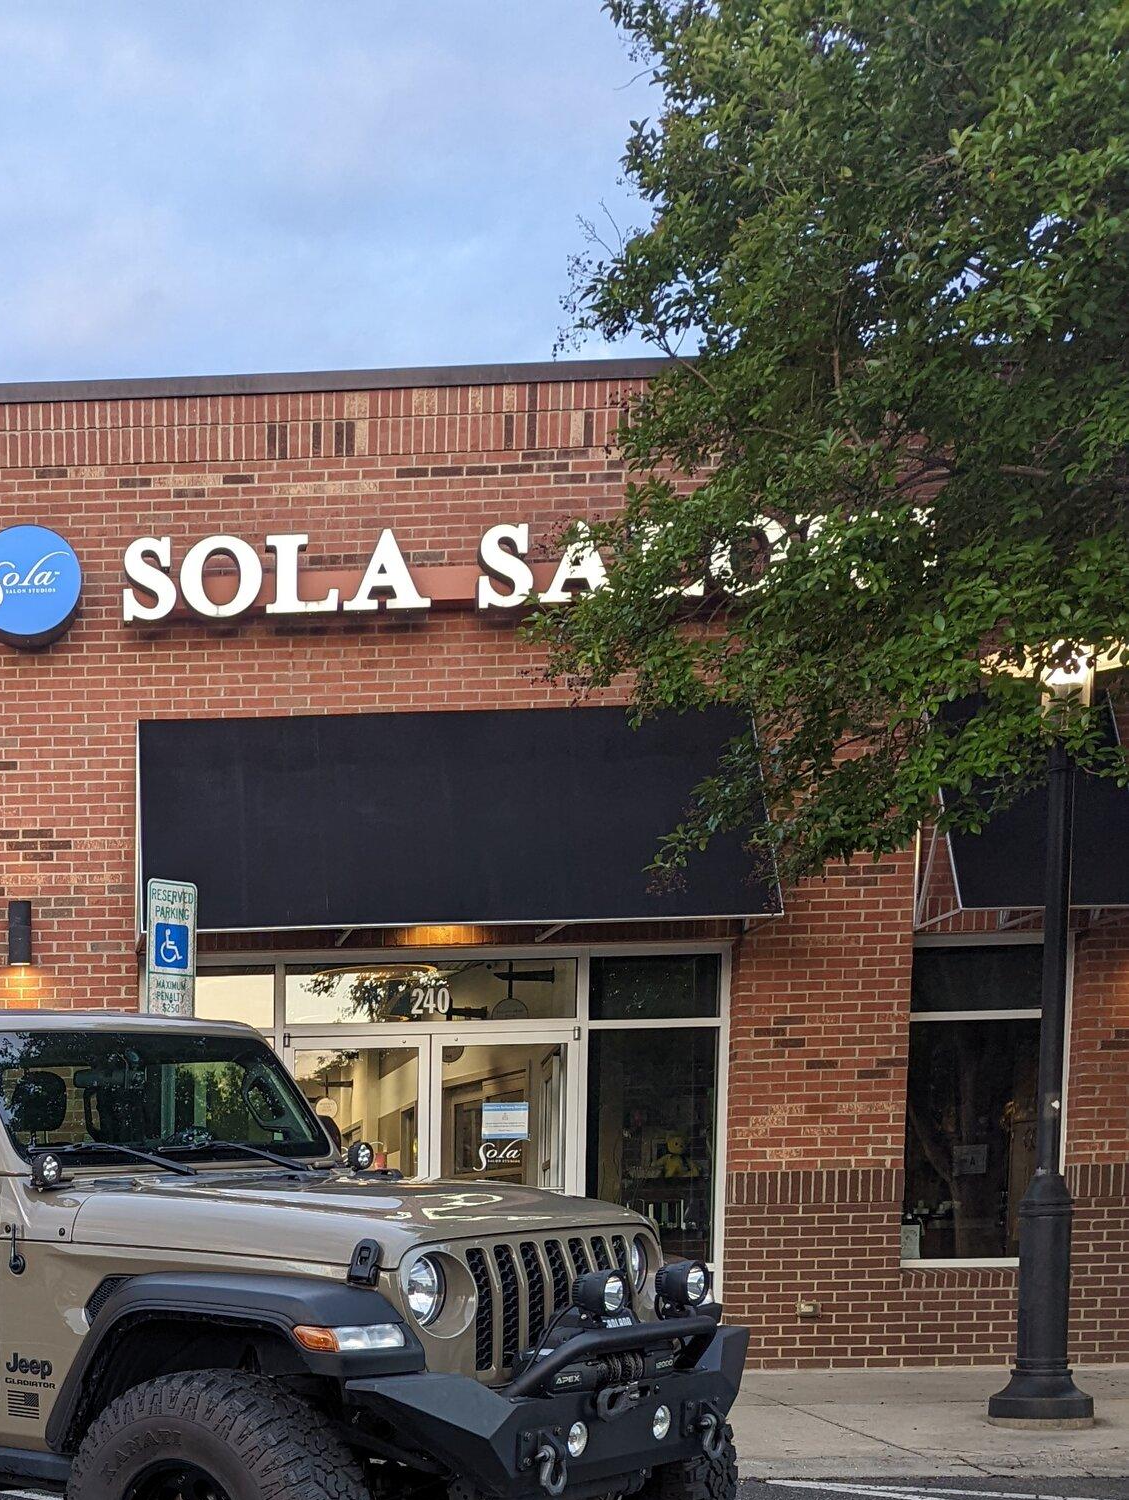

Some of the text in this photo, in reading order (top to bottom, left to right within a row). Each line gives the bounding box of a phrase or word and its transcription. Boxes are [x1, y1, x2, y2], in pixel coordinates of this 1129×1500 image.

[123, 528, 432, 621] SOLA
[151, 888, 194, 904] RESERVED
[155, 905, 190, 920] PARKING
[156, 979, 187, 991] MAXIMUM
[156, 991, 185, 1004] PENALTY
[411, 987, 450, 1015] 240
[161, 1003, 180, 1013] $250
[473, 1138, 531, 1172] Sola
[6, 1352, 53, 1379] Jeep
[5, 1377, 56, 1389] GLADIATOR
[555, 1374, 581, 1385] APEX
